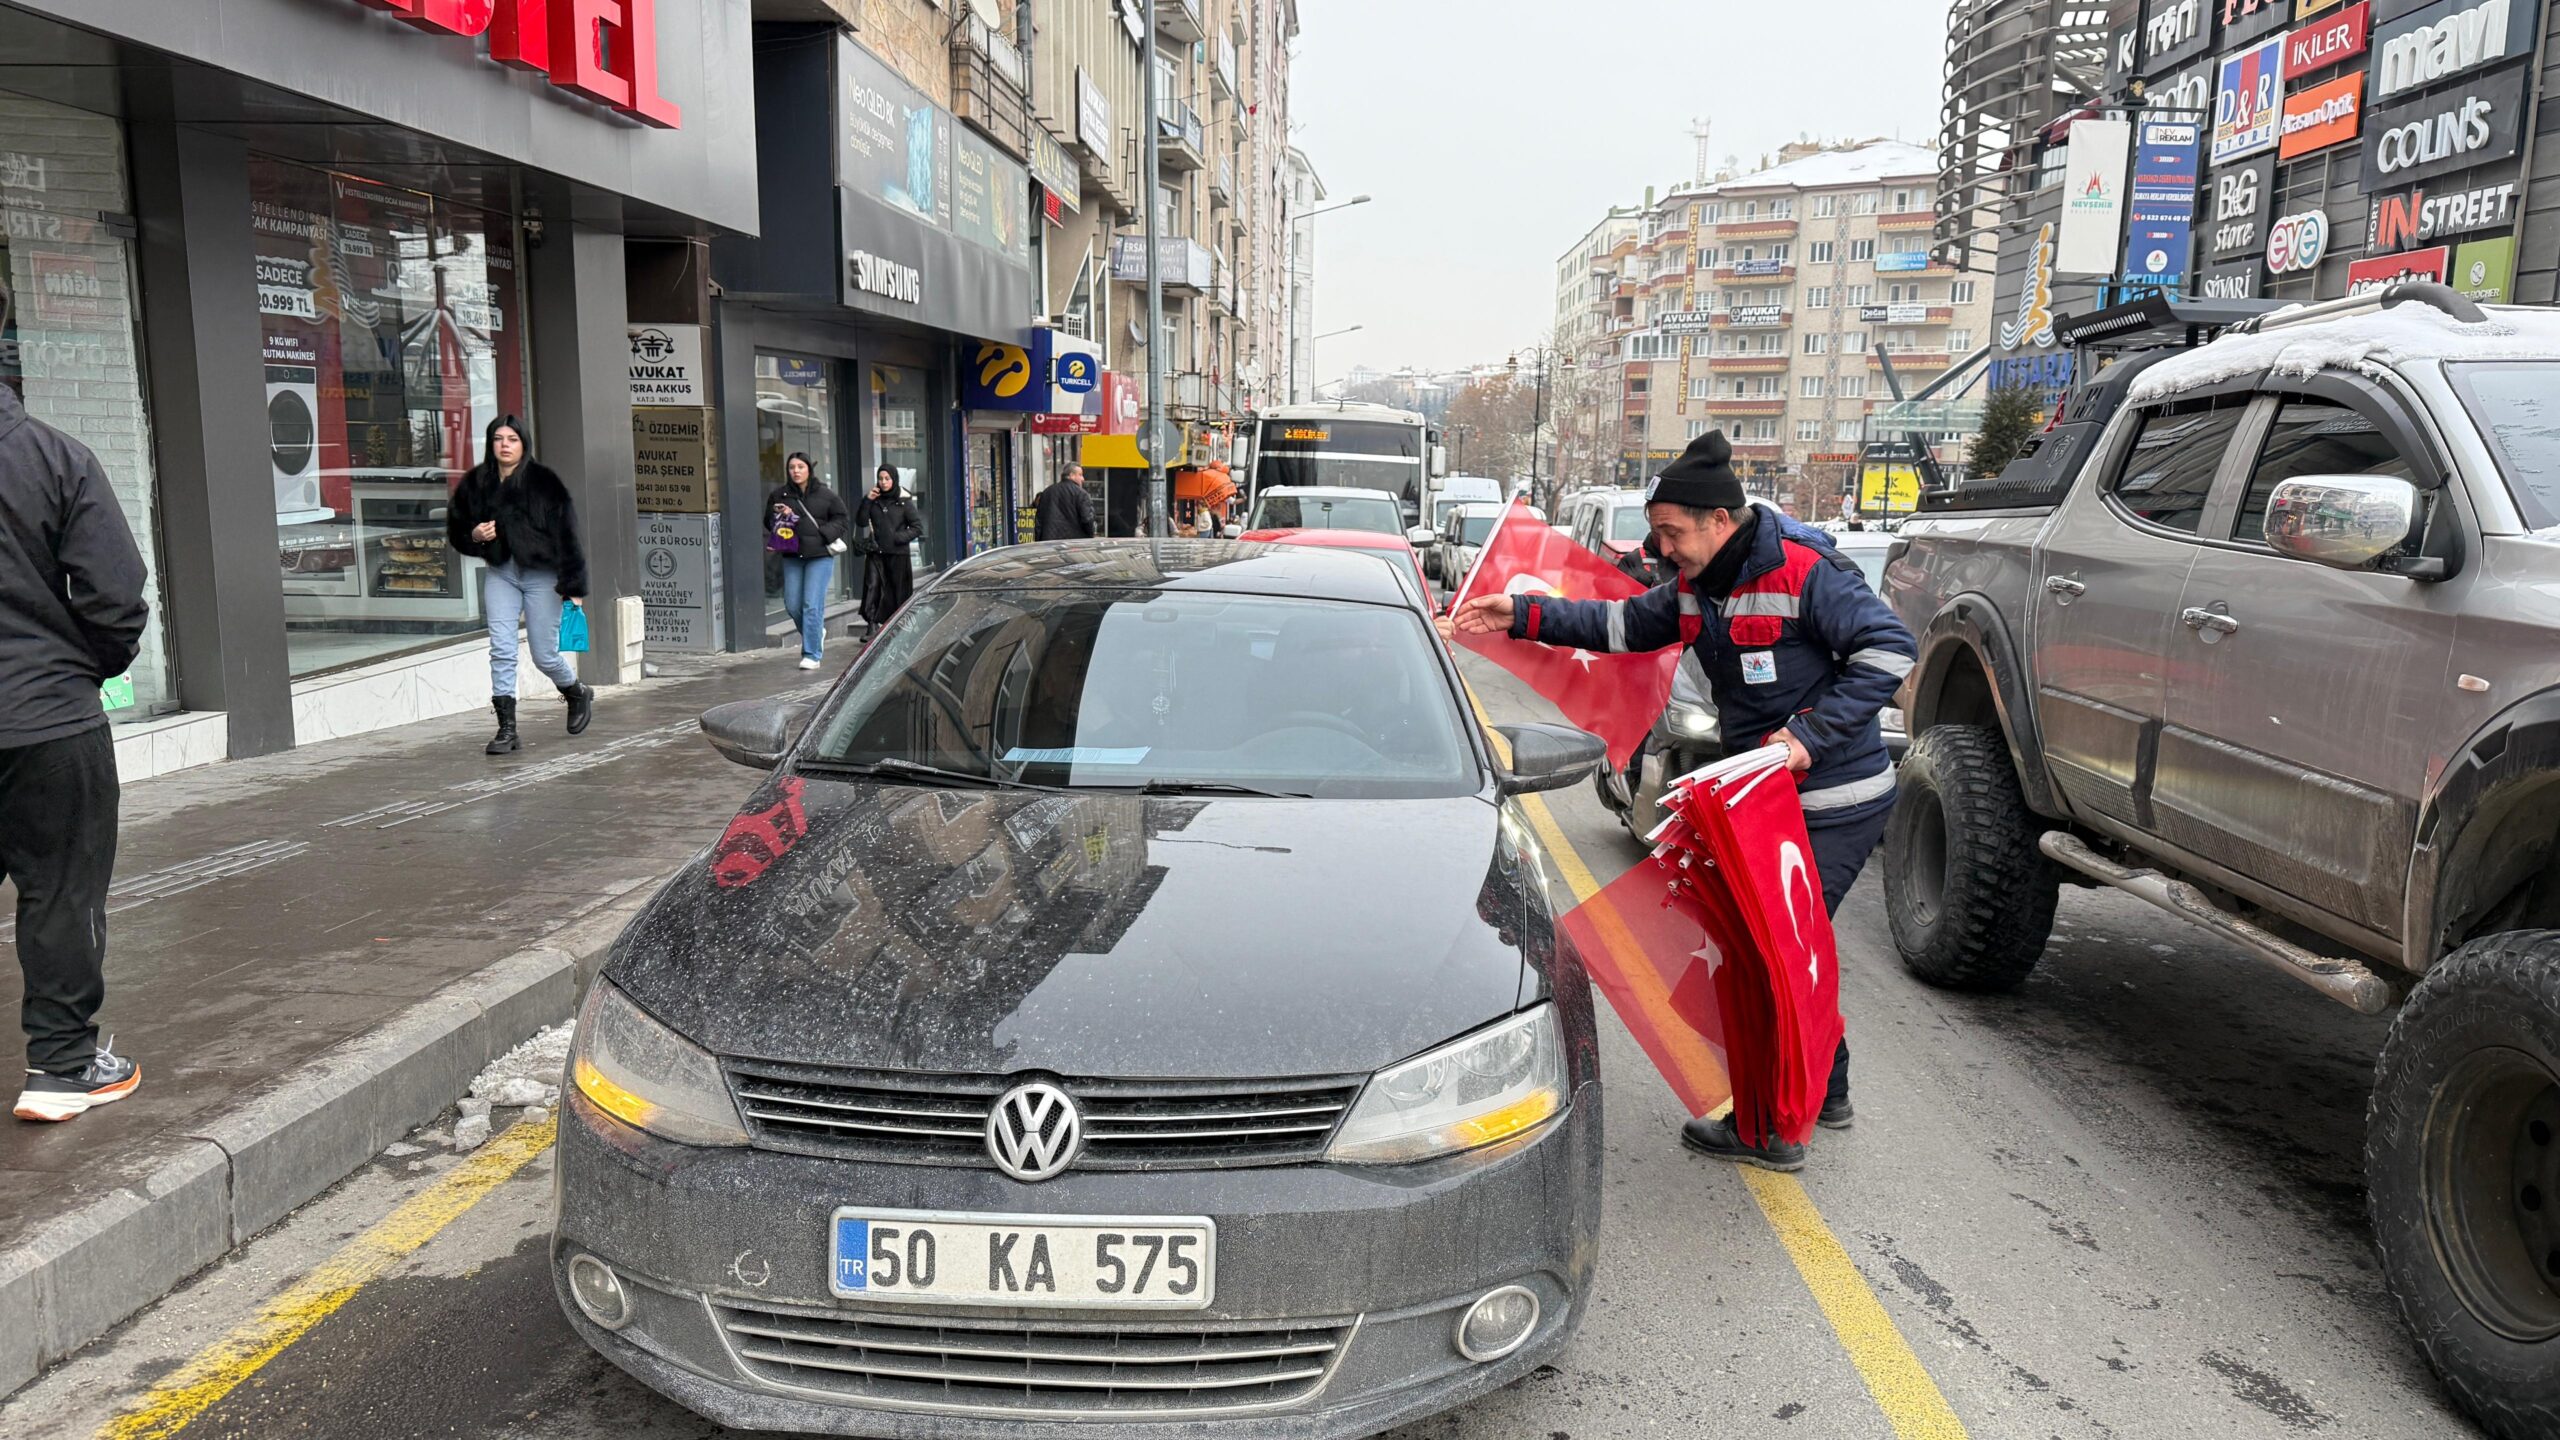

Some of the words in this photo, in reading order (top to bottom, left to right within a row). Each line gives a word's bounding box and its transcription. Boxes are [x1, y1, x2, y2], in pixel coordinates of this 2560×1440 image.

[2219, 73, 2272, 129] D&R
[2215, 125, 2271, 154] STORE
[2377, 96, 2492, 174] COLIN'S
[251, 200, 329, 228] STELLENDİREN
[2419, 183, 2514, 233] STREET
[269, 219, 328, 242] KAMPANYASI
[345, 229, 368, 241] SADECE
[2367, 202, 2379, 252] SPORT
[2213, 223, 2255, 252] store
[2268, 213, 2324, 272] eve
[256, 264, 304, 286] SADECE
[853, 250, 920, 304] SAMSUNG
[295, 297, 312, 314] TL
[1741, 306, 1780, 316] AVUKAT
[491, 313, 501, 328] TL
[1663, 313, 1708, 323] AVUKAT
[269, 336, 274, 346] 9
[275, 337, 286, 347] KG
[262, 344, 287, 359] RUTMA
[286, 347, 316, 362] MAKİNESİ
[1060, 377, 1093, 387] TURKCELL
[649, 419, 699, 435] ÖZDEMİR
[638, 450, 678, 461] AVUKAT
[635, 463, 658, 475] BRA
[660, 465, 695, 477] ŞENER
[650, 522, 673, 533] GÜN
[660, 535, 703, 546] BÜROSU
[645, 581, 678, 589] AVUKAT
[641, 589, 664, 598] RKAN
[664, 588, 694, 599] GÜNEY
[644, 616, 661, 625] TİN
[662, 616, 692, 626] GÜNAY
[646, 610, 679, 618] AVUKAT
[840, 1258, 865, 1276] TR
[871, 1227, 937, 1289] 50
[988, 1231, 1057, 1293] KA
[1095, 1232, 1199, 1296] 575
